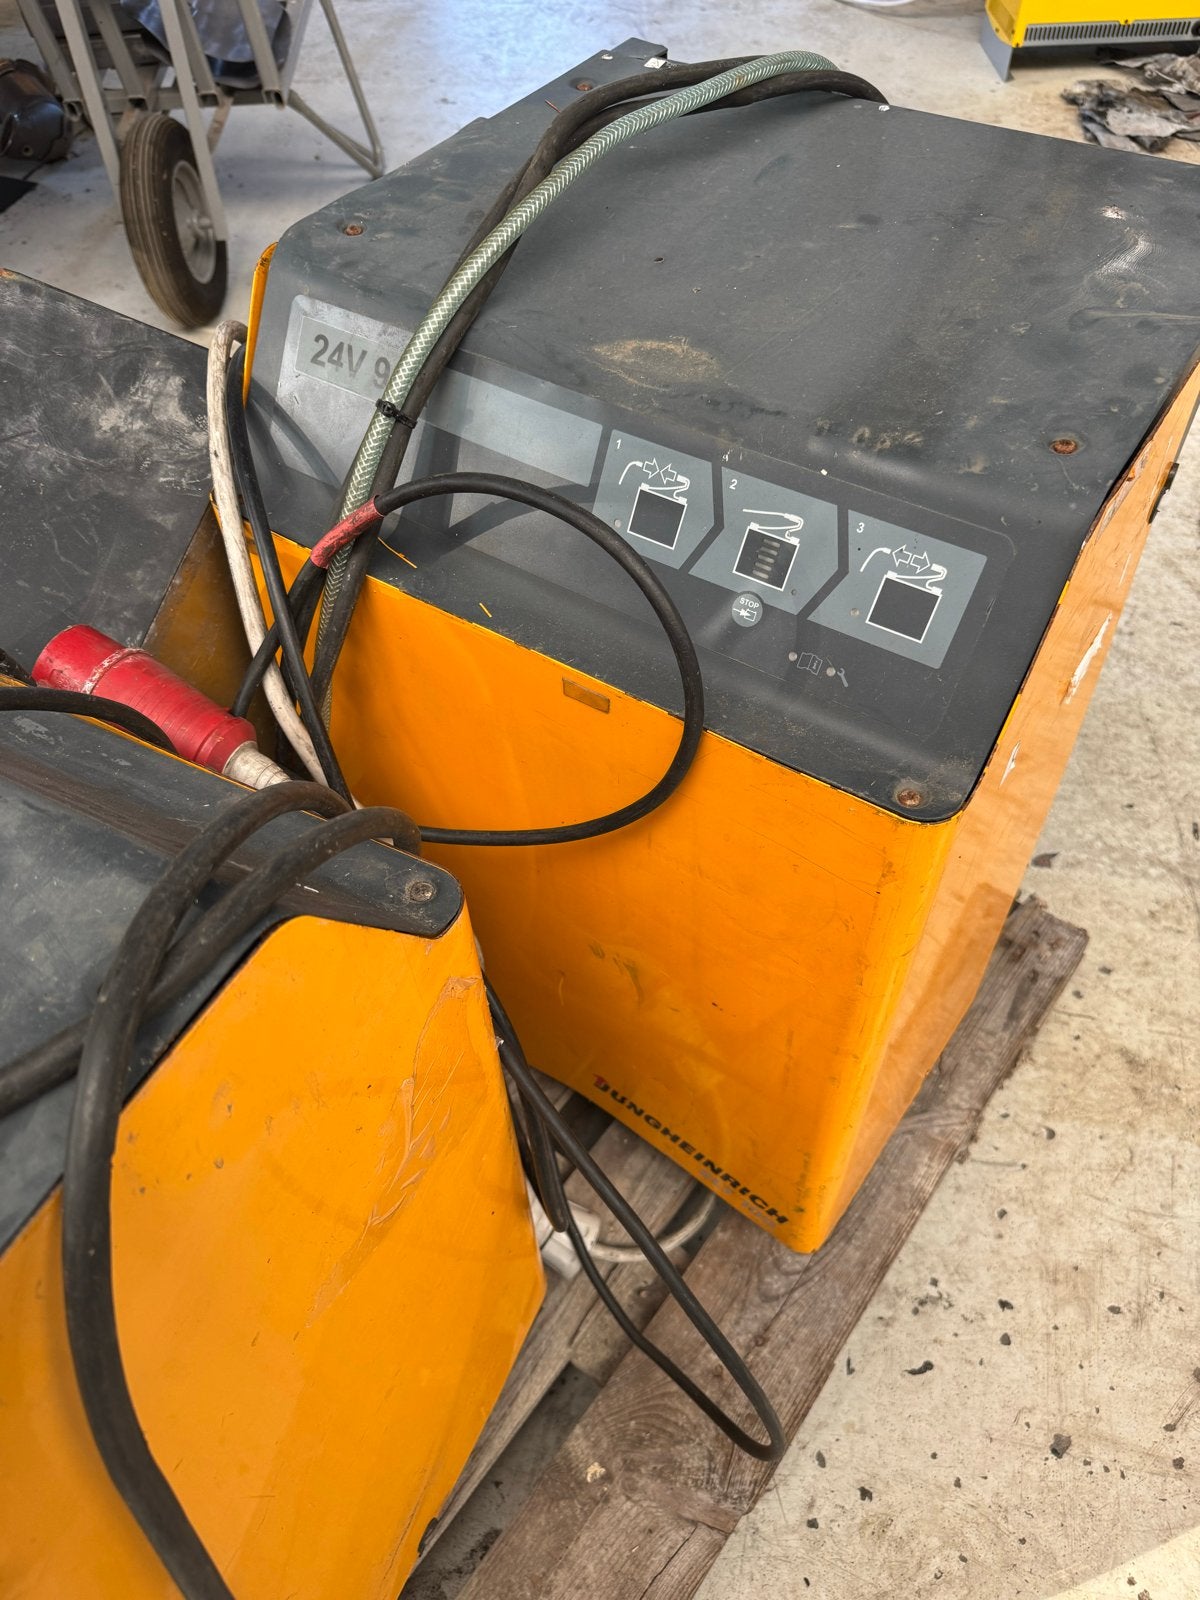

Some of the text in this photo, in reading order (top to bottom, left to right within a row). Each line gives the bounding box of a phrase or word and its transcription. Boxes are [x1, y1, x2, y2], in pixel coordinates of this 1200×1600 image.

[310, 333, 368, 377] 24V
[615, 439, 622, 450] 1
[729, 478, 738, 490] 2
[856, 522, 865, 534] 3
[739, 597, 760, 609] STOP
[593, 1073, 789, 1225] JUNGHEINRICH
